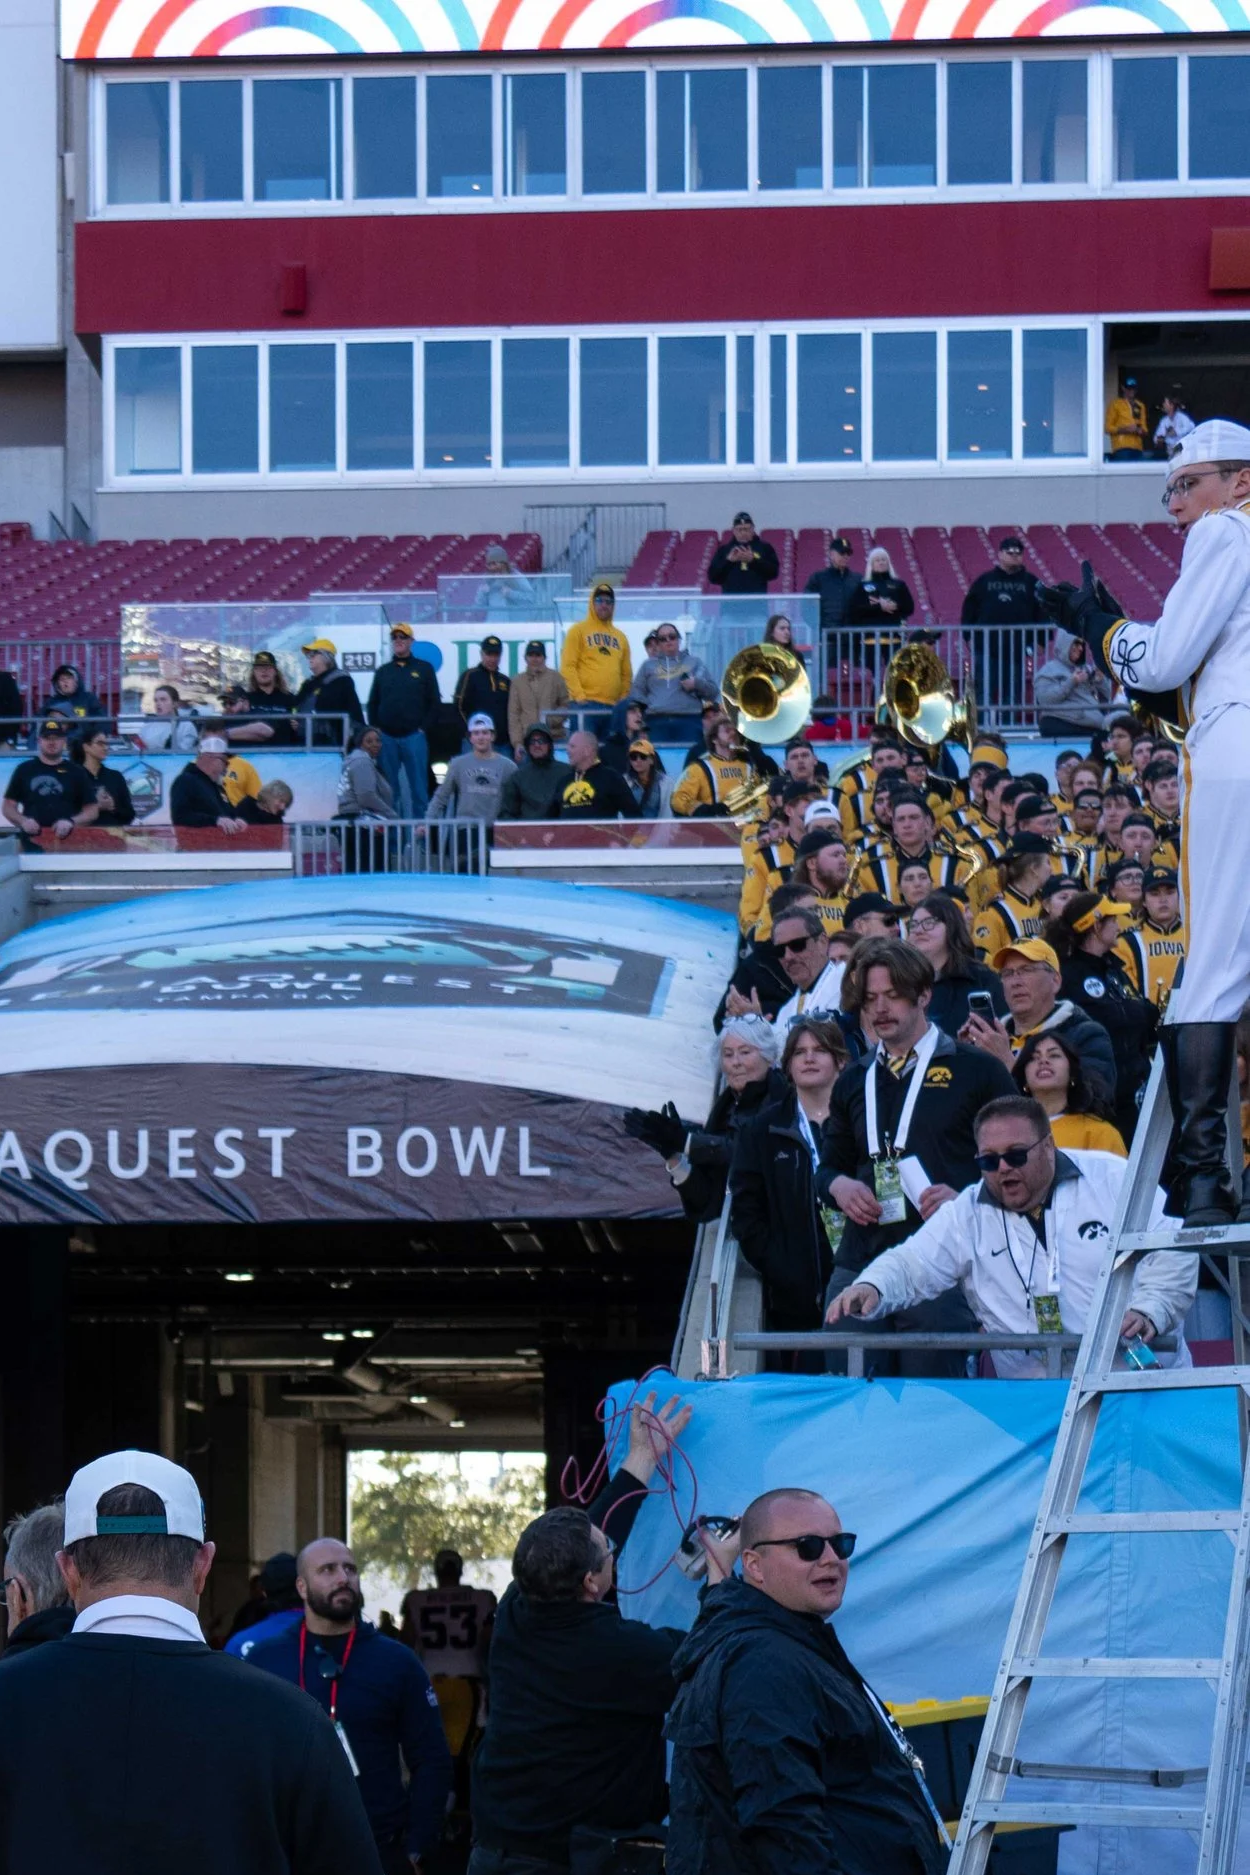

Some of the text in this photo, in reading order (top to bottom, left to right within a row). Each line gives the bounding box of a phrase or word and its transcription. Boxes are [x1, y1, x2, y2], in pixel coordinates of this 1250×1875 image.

[586, 631, 621, 651] IOWA
[344, 655, 374, 668] 219
[720, 767, 744, 780] IOWA
[347, 1125, 551, 1178] BOWL
[419, 1604, 477, 1649] 53
